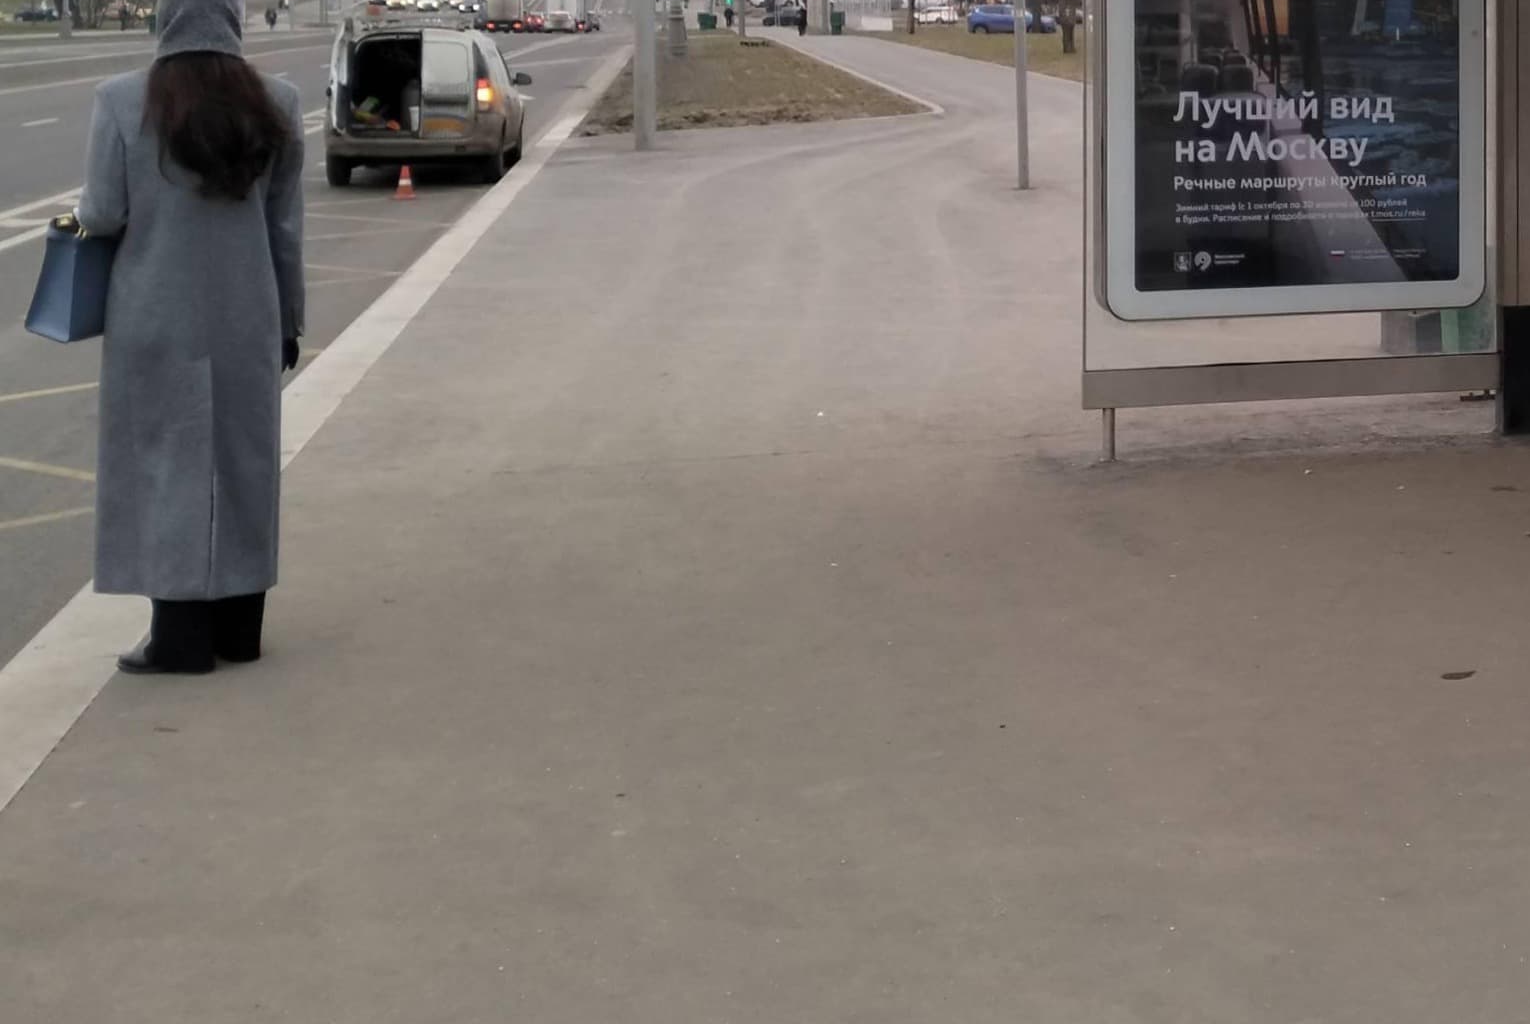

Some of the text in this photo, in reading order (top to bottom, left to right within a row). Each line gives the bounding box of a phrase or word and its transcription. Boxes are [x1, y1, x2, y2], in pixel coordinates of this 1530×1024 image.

[1173, 90, 1394, 128] Лучший вид
[1175, 131, 1368, 167] на Москву
[1174, 172, 1427, 191] Речные маршруты круглый год
